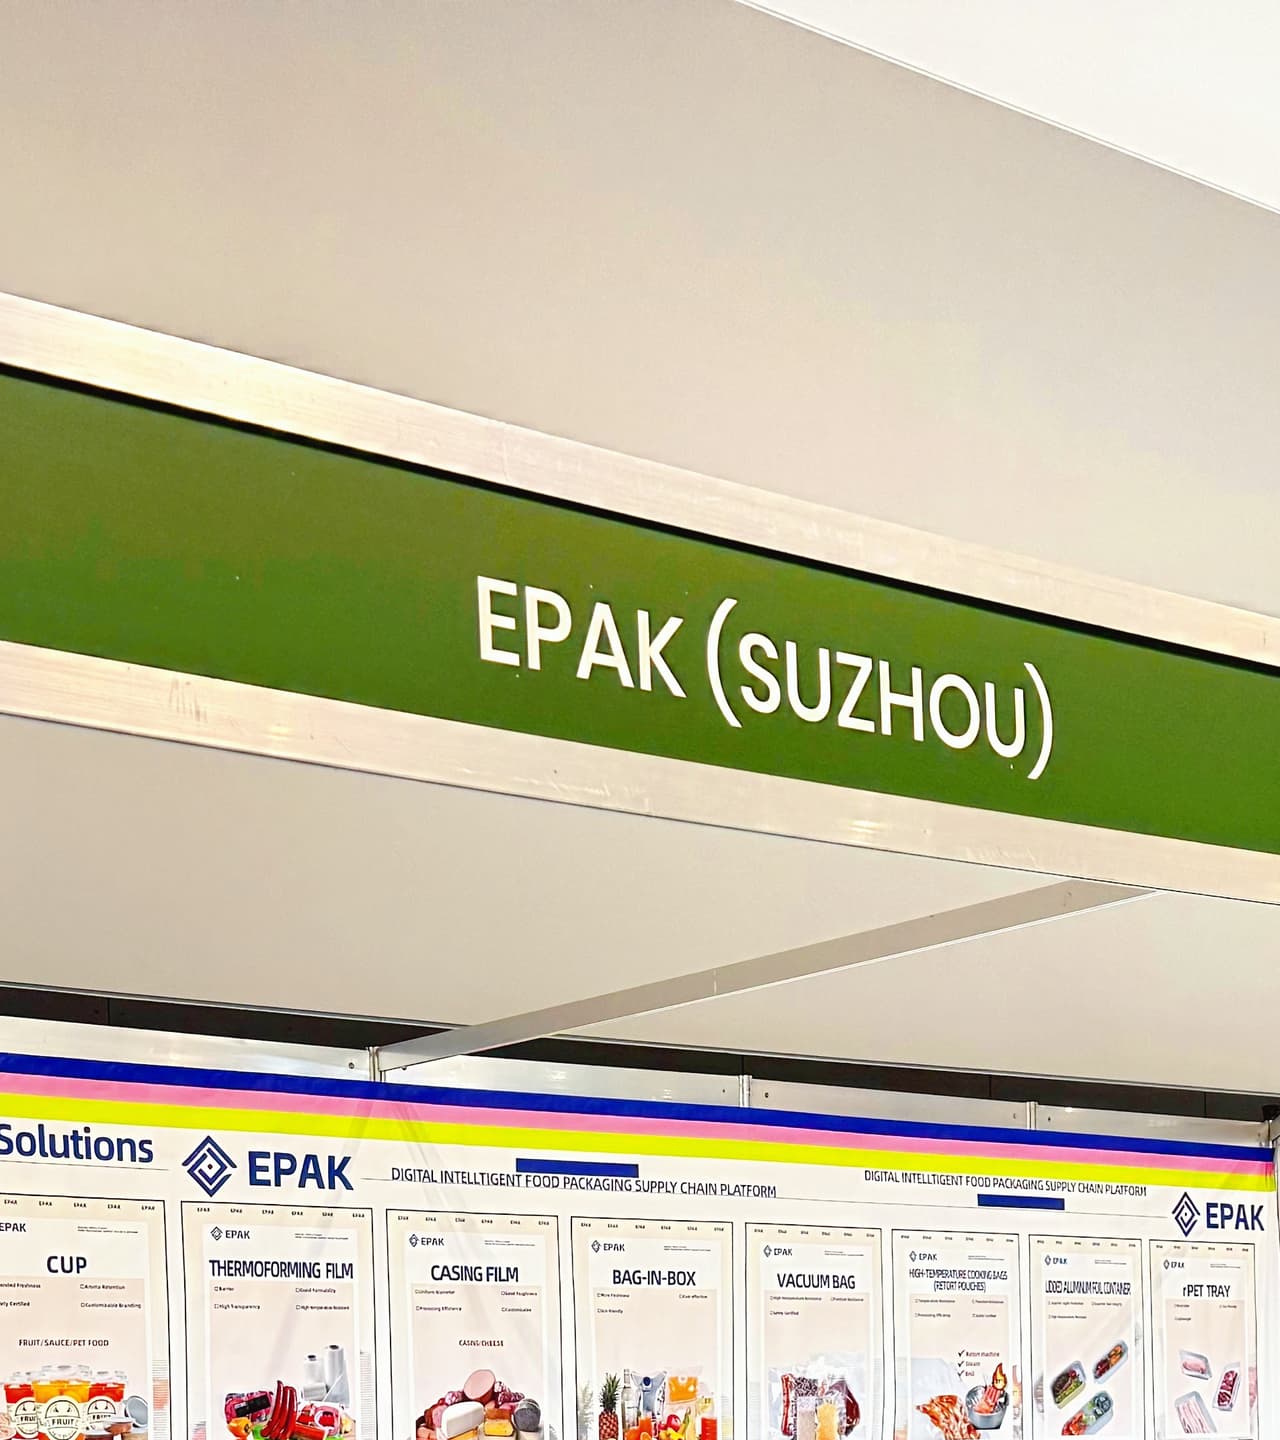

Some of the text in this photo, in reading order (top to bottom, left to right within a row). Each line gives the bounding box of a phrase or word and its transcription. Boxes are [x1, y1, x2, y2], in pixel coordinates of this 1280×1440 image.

[476, 575, 1053, 779] EPAK (SUZHOU)
[247, 1150, 354, 1191] EPAK
[391, 1167, 436, 1184] DIGITAL
[525, 1174, 560, 1189] FOOD
[563, 1177, 632, 1193] PACKAGING
[635, 1180, 677, 1195] SUPPLY
[680, 1181, 717, 1196] CHAIN
[720, 1183, 777, 1198] PLATFORM
[1206, 1202, 1264, 1231] EPAK
[46, 1255, 87, 1274] CUP
[209, 1259, 353, 1280] THERMOFORMING FILM
[431, 1263, 519, 1284] CASING FILM
[612, 1269, 696, 1286] BAG-IN-BOX
[777, 1272, 855, 1290] VACUUM BAG
[1206, 1284, 1230, 1298] TRAY
